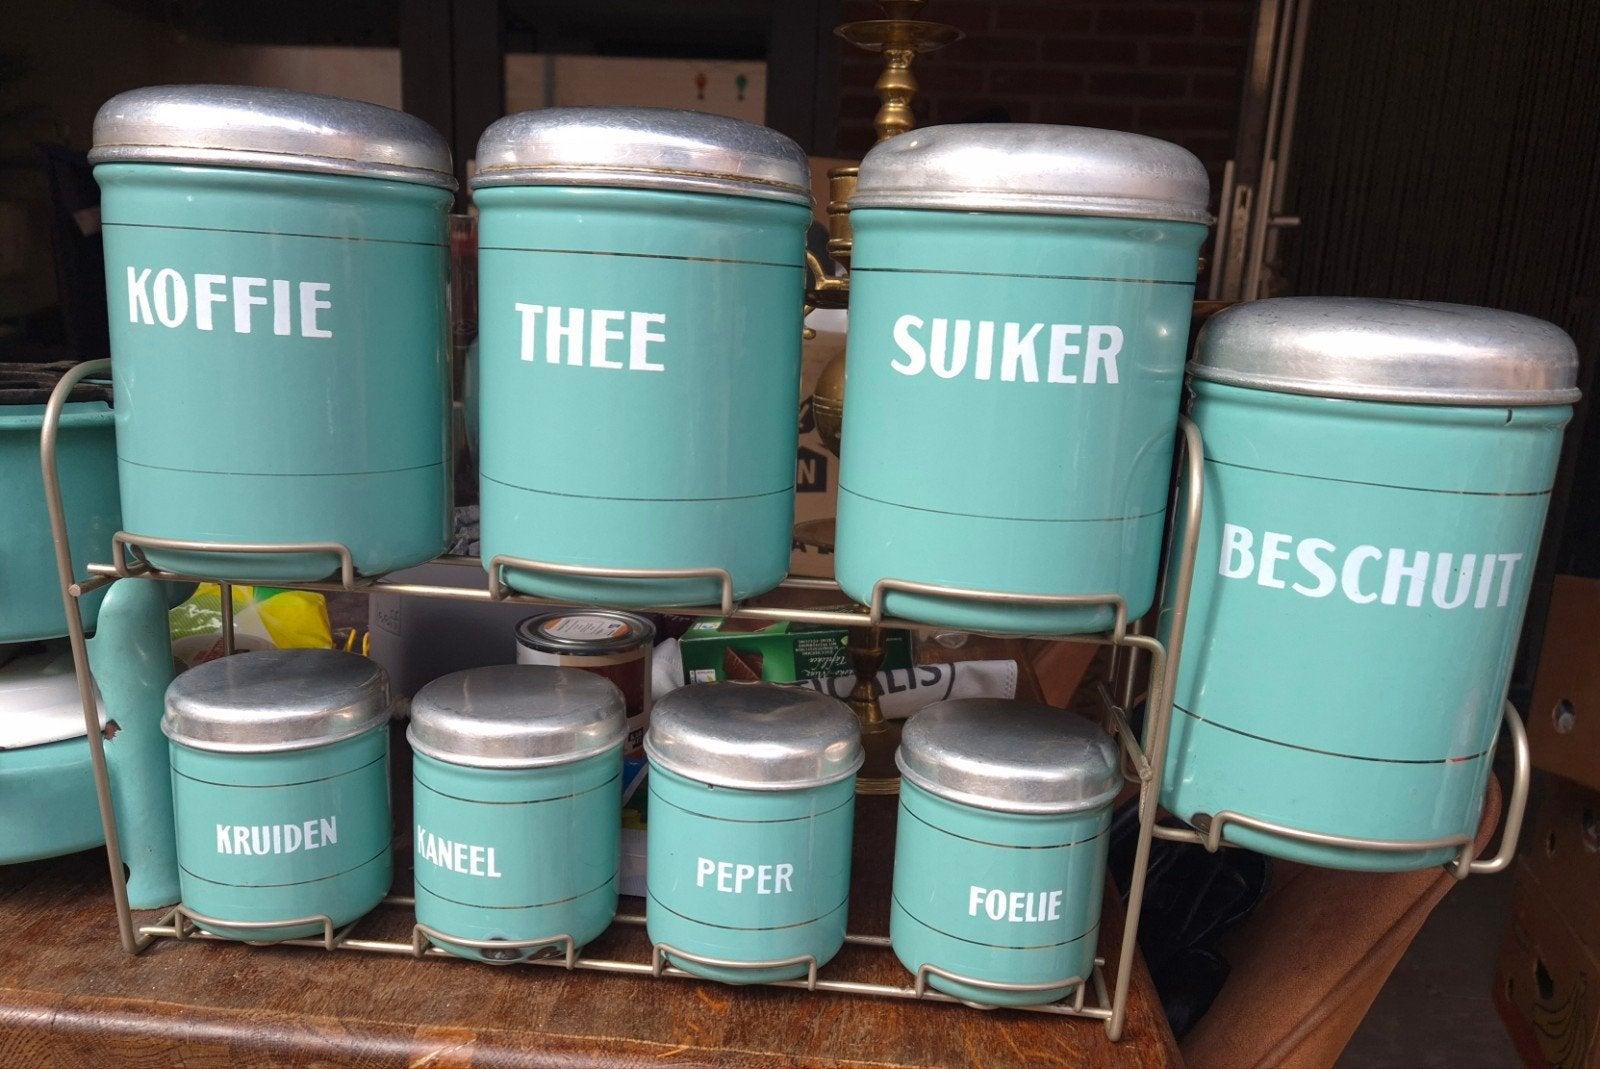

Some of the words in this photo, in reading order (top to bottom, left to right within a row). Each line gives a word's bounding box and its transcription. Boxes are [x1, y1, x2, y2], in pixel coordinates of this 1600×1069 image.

[126, 265, 333, 339] KOFFIE
[515, 302, 667, 372] THEE
[891, 313, 1124, 385] SUIKER
[1219, 523, 1525, 611] BESCHUIT
[216, 816, 338, 856] KRUIDEN
[417, 825, 502, 878] KANEEL
[695, 857, 794, 895] PEPER
[968, 886, 1063, 924] FOELIE
